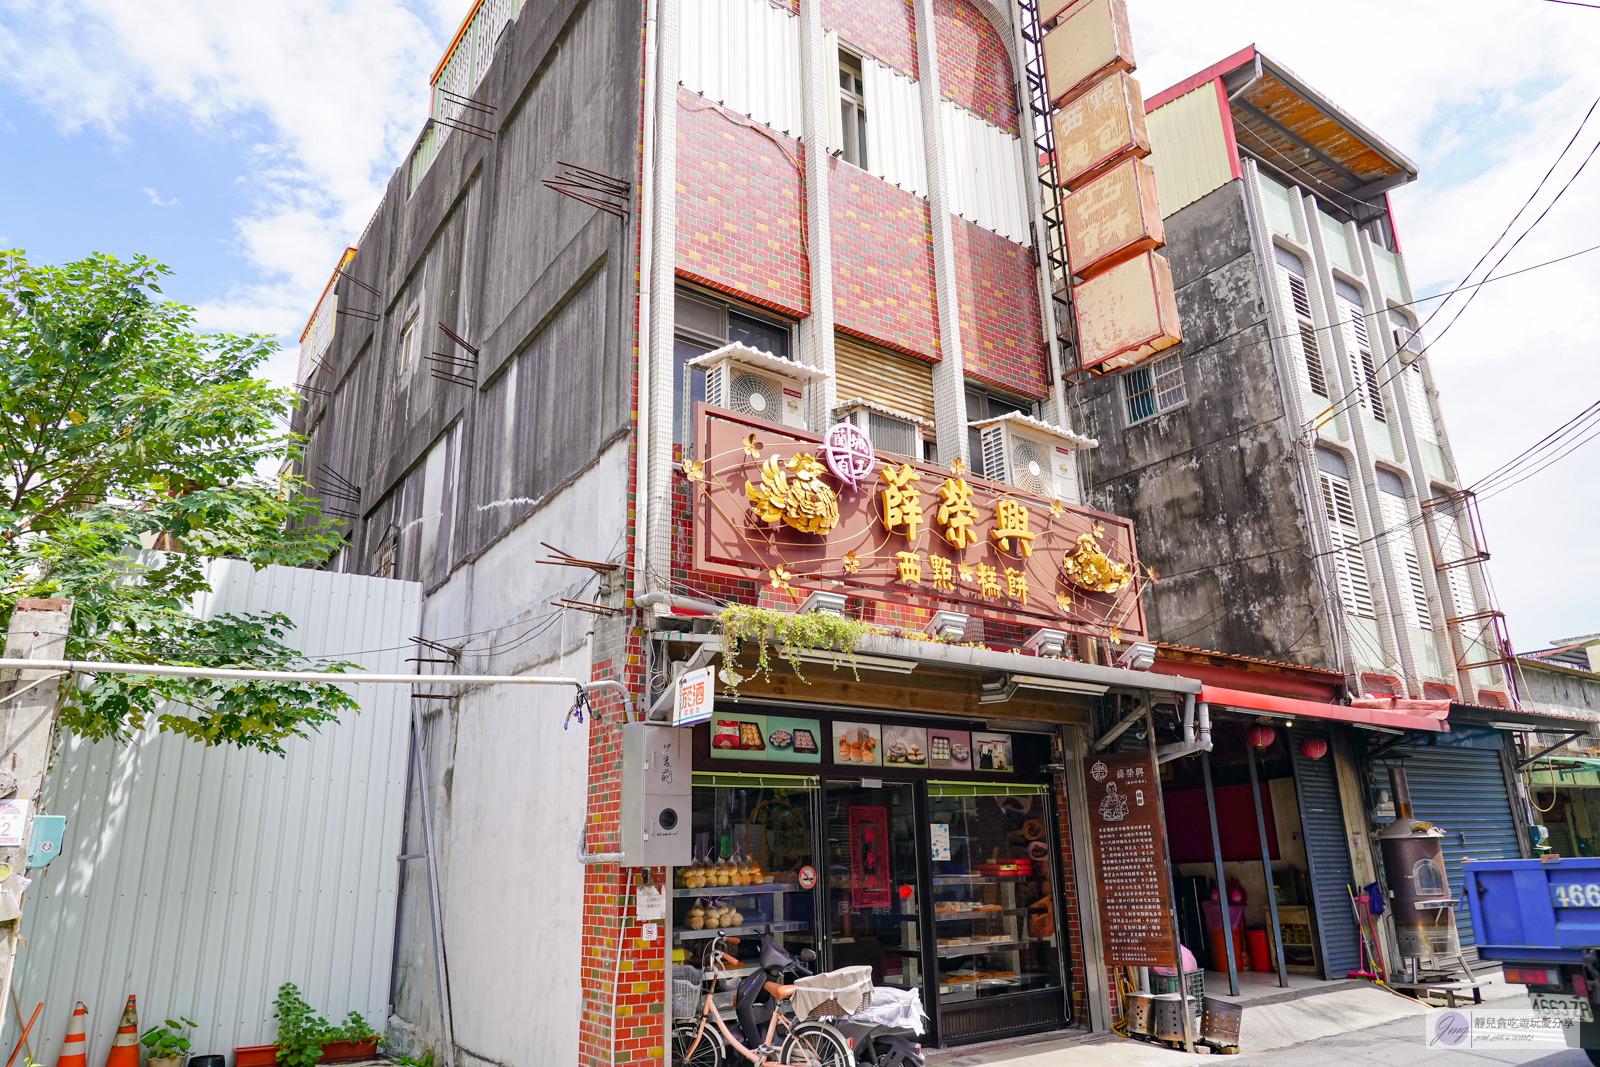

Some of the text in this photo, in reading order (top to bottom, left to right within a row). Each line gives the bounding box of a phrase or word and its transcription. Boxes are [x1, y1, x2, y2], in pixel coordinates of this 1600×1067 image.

[880, 463, 1036, 558] 薛榮興
[895, 550, 1028, 606] 西點糕餅
[681, 681, 705, 710] 菸酒
